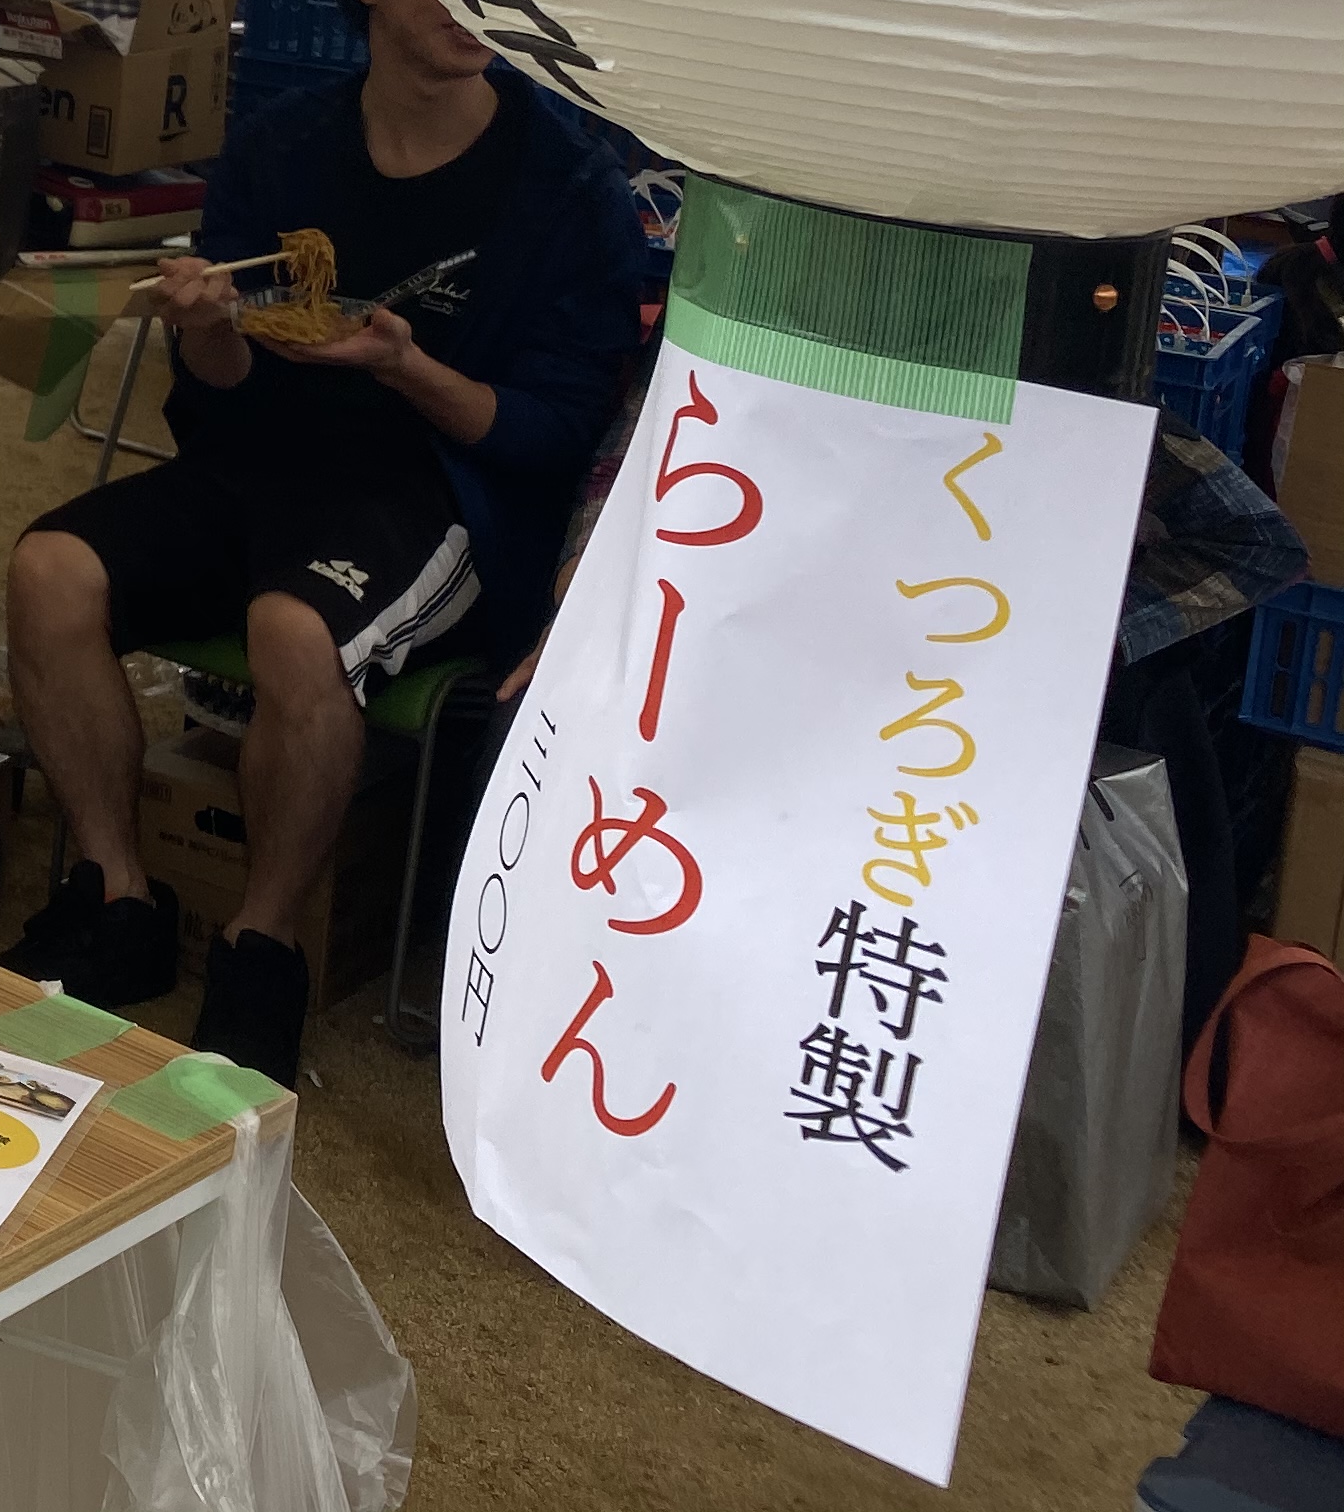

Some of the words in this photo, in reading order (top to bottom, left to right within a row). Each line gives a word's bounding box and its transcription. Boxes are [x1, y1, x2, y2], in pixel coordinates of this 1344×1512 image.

[162, 74, 188, 131] R
[540, 369, 765, 1138] らーめん
[783, 431, 1011, 1173] くつろぎ特製
